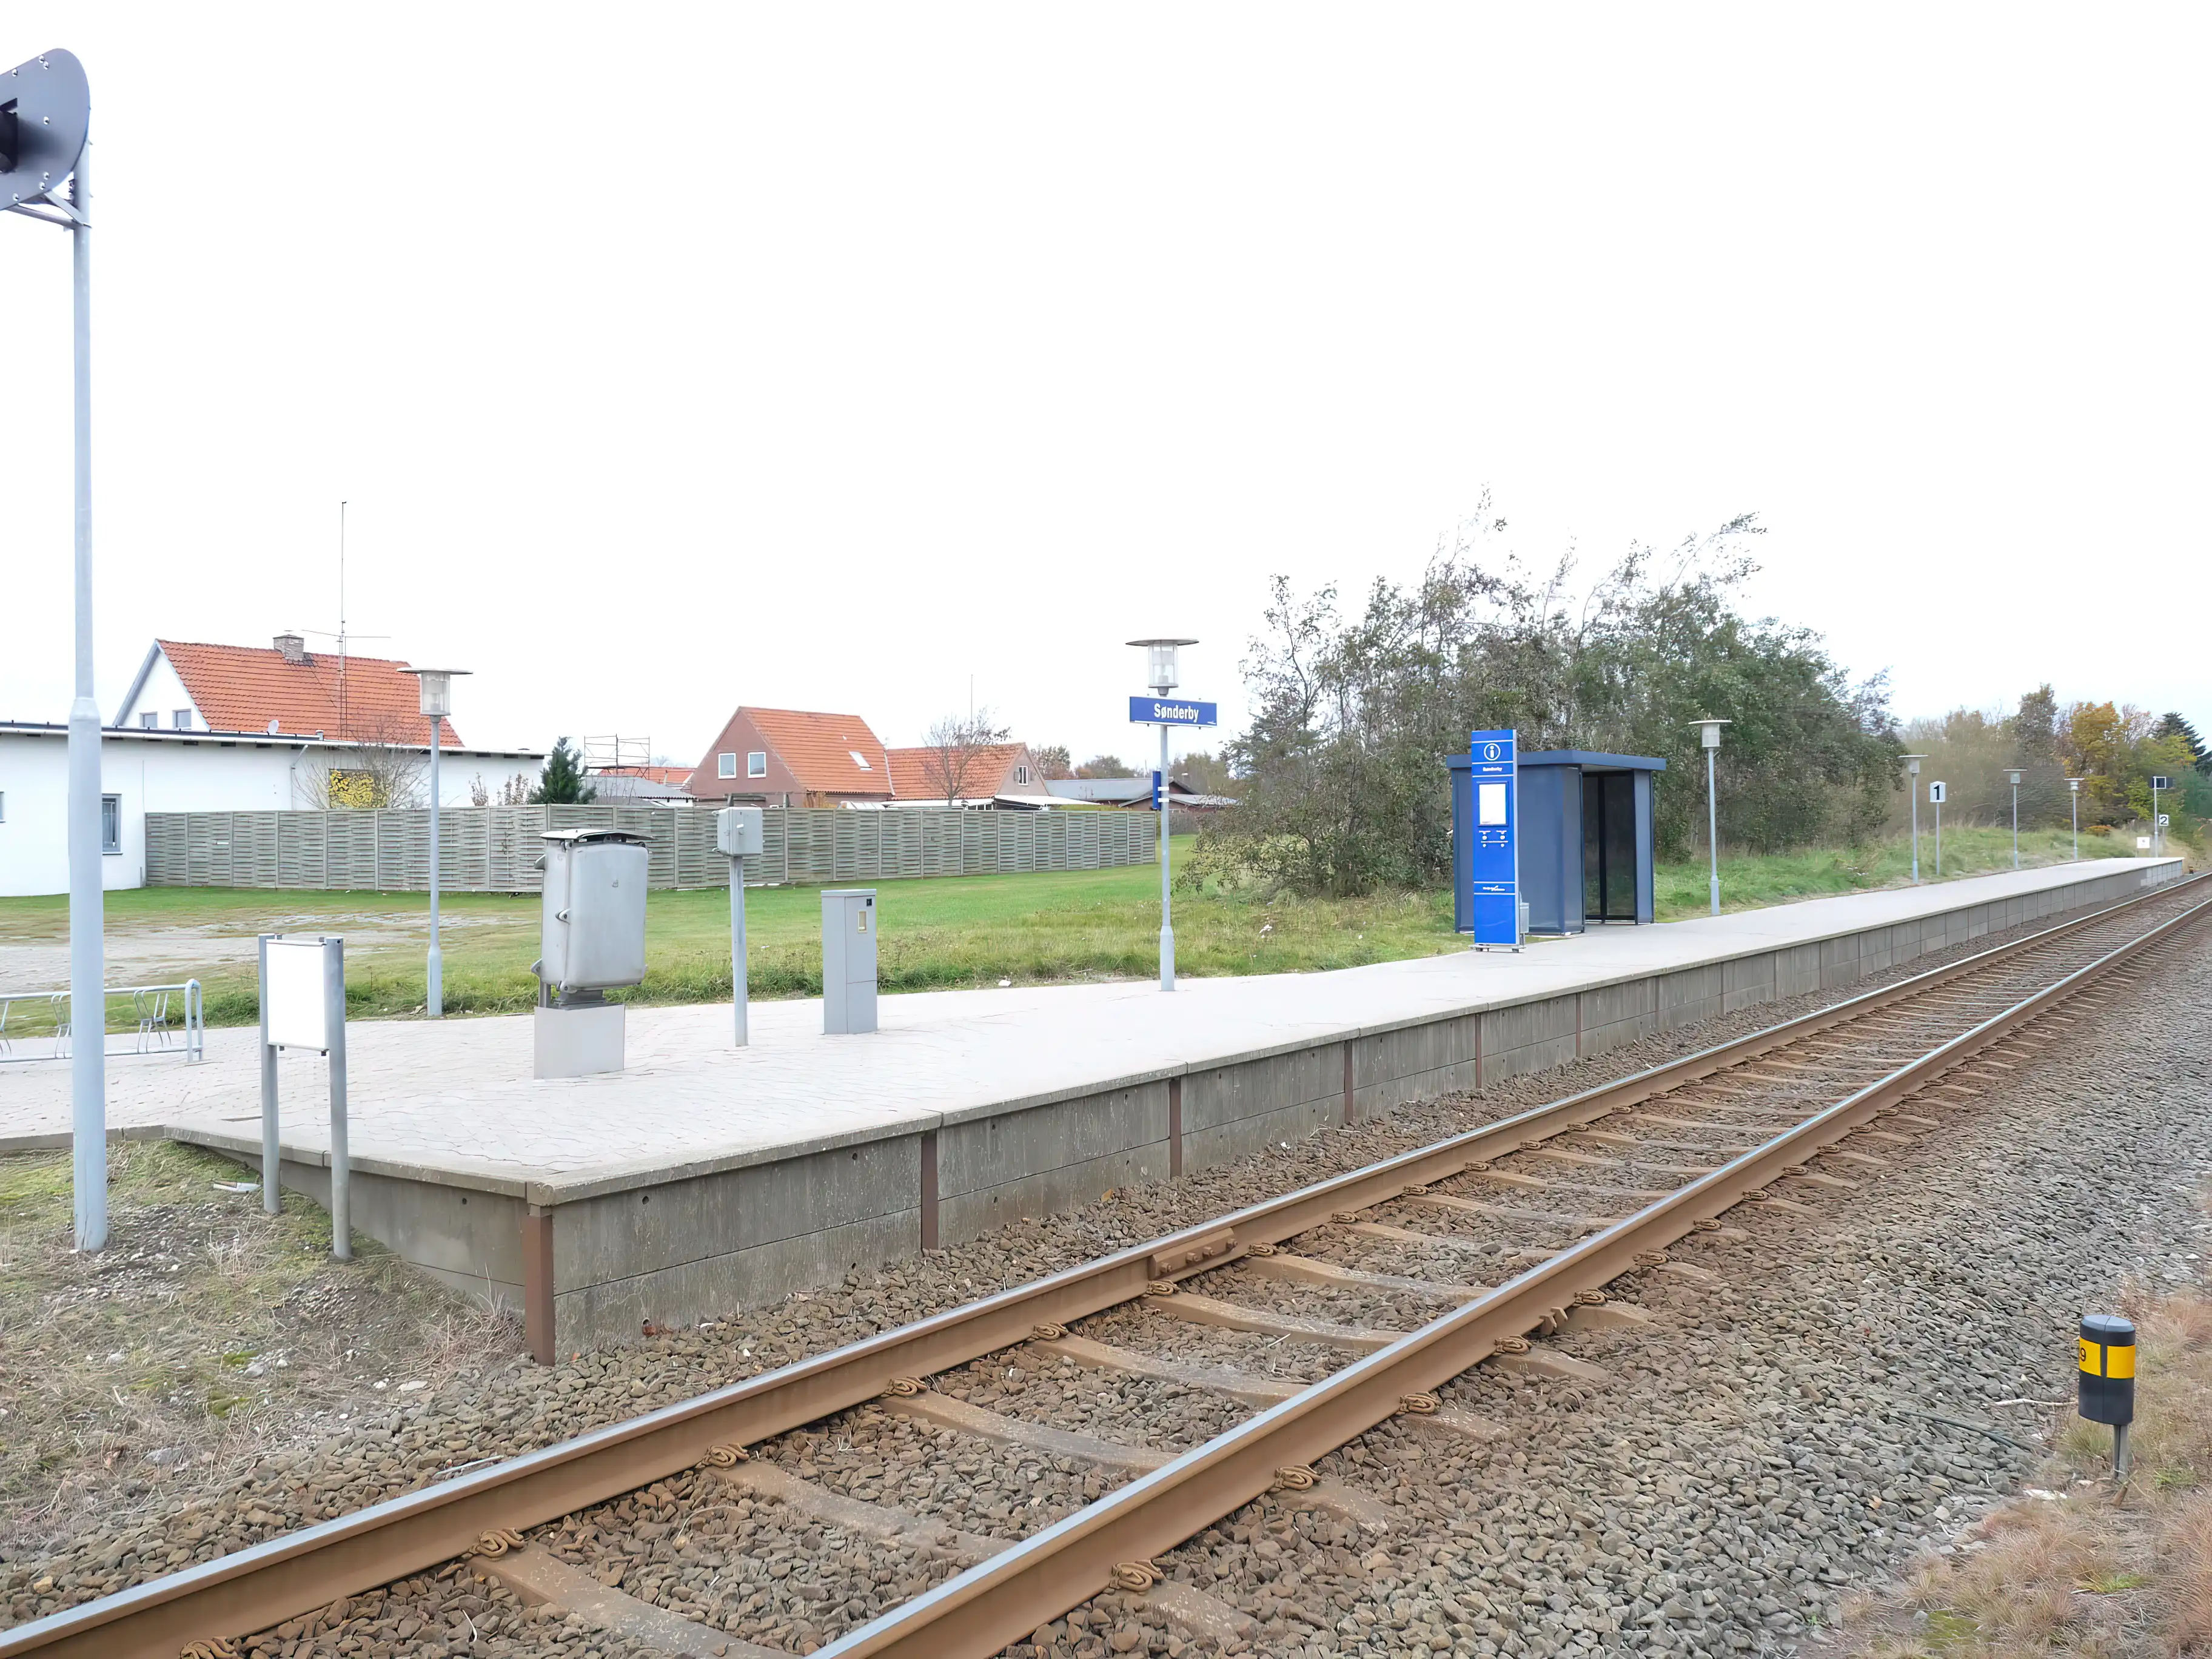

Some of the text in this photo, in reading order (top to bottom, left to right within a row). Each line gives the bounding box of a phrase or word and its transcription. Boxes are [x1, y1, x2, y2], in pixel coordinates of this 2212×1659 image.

[1154, 703, 1199, 723] Sønderby
[1934, 785, 1940, 800] 1
[2160, 816, 2168, 825] 2
